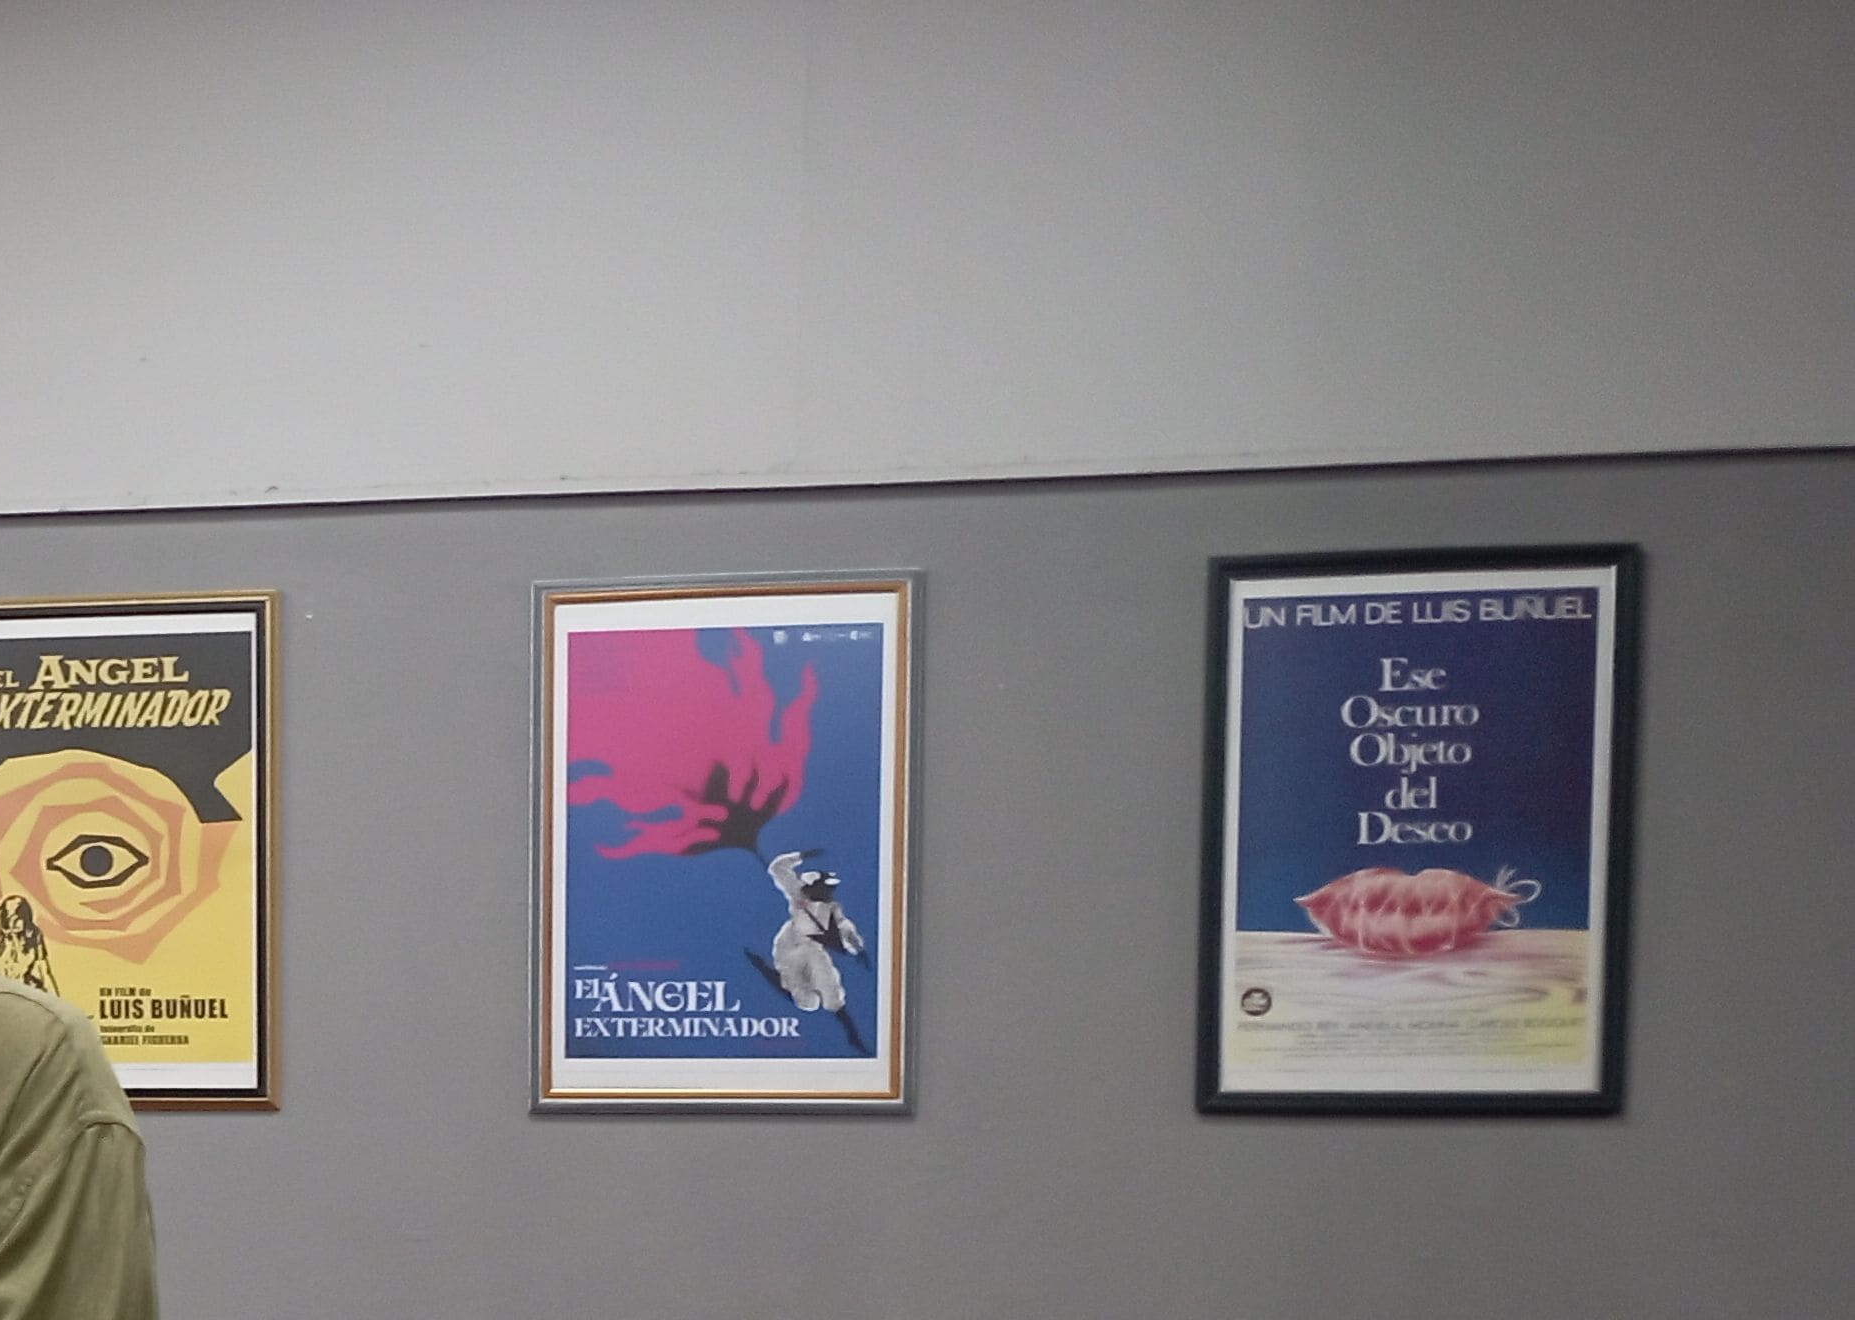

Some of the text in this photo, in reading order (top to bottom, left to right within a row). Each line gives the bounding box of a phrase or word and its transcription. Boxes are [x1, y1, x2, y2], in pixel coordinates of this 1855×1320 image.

[1245, 607, 1285, 629] UN
[1296, 603, 1357, 627] FILM
[1364, 601, 1404, 625] DE
[1411, 600, 1472, 624] LUIS
[28, 654, 190, 690] ANGEL
[1379, 656, 1447, 692] Ese
[1340, 694, 1481, 729] Oscuro
[1349, 731, 1473, 773] Objeto
[1384, 776, 1438, 810] del
[1356, 811, 1473, 846] Deseo
[99, 994, 229, 1020] LUIS BUÑUEL
[592, 971, 742, 1013] ÁNGEL
[574, 1016, 801, 1038] EXTERMINADOR
